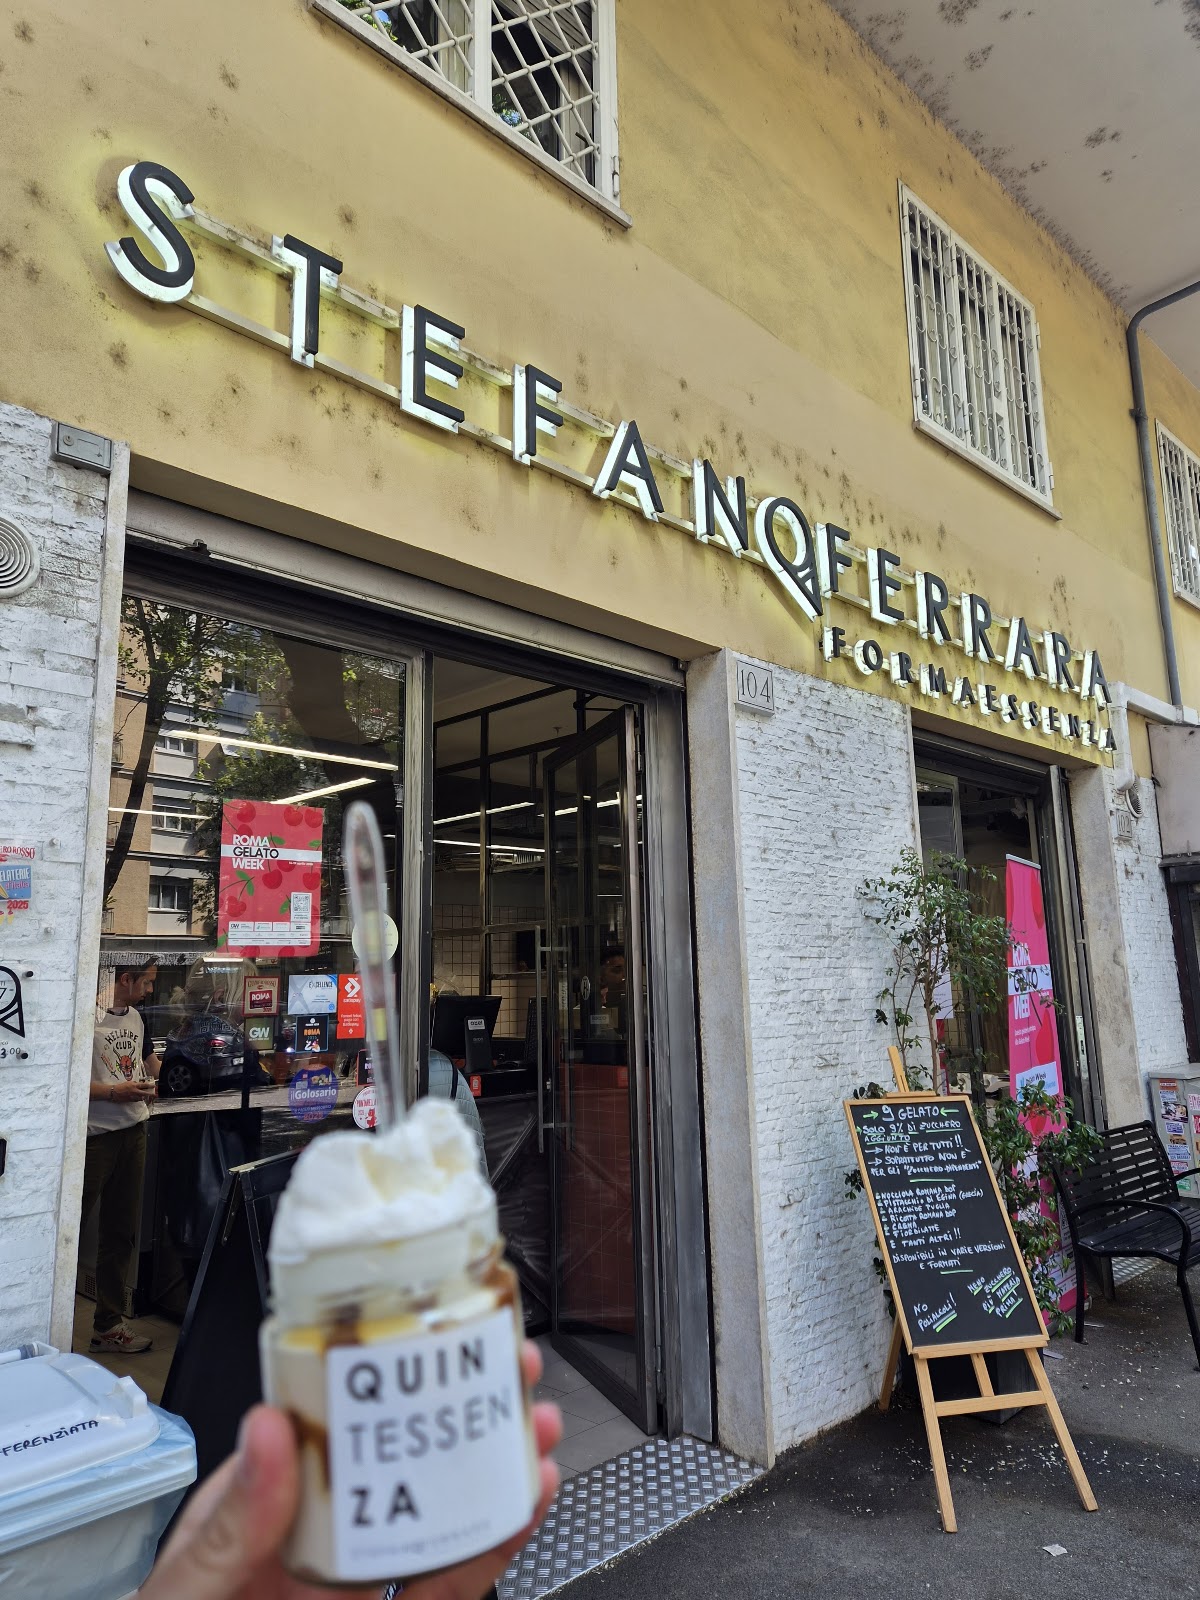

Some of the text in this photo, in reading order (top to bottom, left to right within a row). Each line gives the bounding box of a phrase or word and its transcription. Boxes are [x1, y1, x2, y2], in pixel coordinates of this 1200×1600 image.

[104, 160, 1111, 708] STEFANO FERRARA
[740, 668, 771, 703] 104
[232, 834, 270, 847] ROMA
[232, 846, 279, 859] GELATO
[232, 857, 265, 870] WEEK
[7, 900, 29, 910] 2025
[251, 993, 270, 1001] ROMA
[104, 1029, 139, 1045] HELLFIRE
[248, 1026, 270, 1038] GW
[115, 1041, 132, 1050] CLUB
[882, 1105, 939, 1121] 9 GELATO
[862, 1125, 885, 1134] SOLO
[890, 1122, 904, 1133] 9%
[920, 1120, 961, 1130] ZUCCHERO
[884, 1144, 901, 1154] NON
[912, 1142, 929, 1152] PER
[885, 1154, 935, 1165] SOPRATTUTTO
[938, 1152, 958, 1161] NON
[870, 1167, 886, 1176] PER
[881, 1184, 956, 1199] NOCCIOLA ROMANA DOP
[919, 1210, 943, 1220] ROMANA
[945, 1208, 957, 1218] DOP
[889, 1240, 896, 1249] E
[919, 1262, 925, 1270] E
[967, 1276, 986, 1294] MENO
[913, 1302, 929, 1317] NO
[346, 1337, 485, 1403] QUIN
[347, 1385, 512, 1466] TESSEN
[0, 1419, 99, 1457] FERENZIATA
[350, 1481, 421, 1528] ZA
